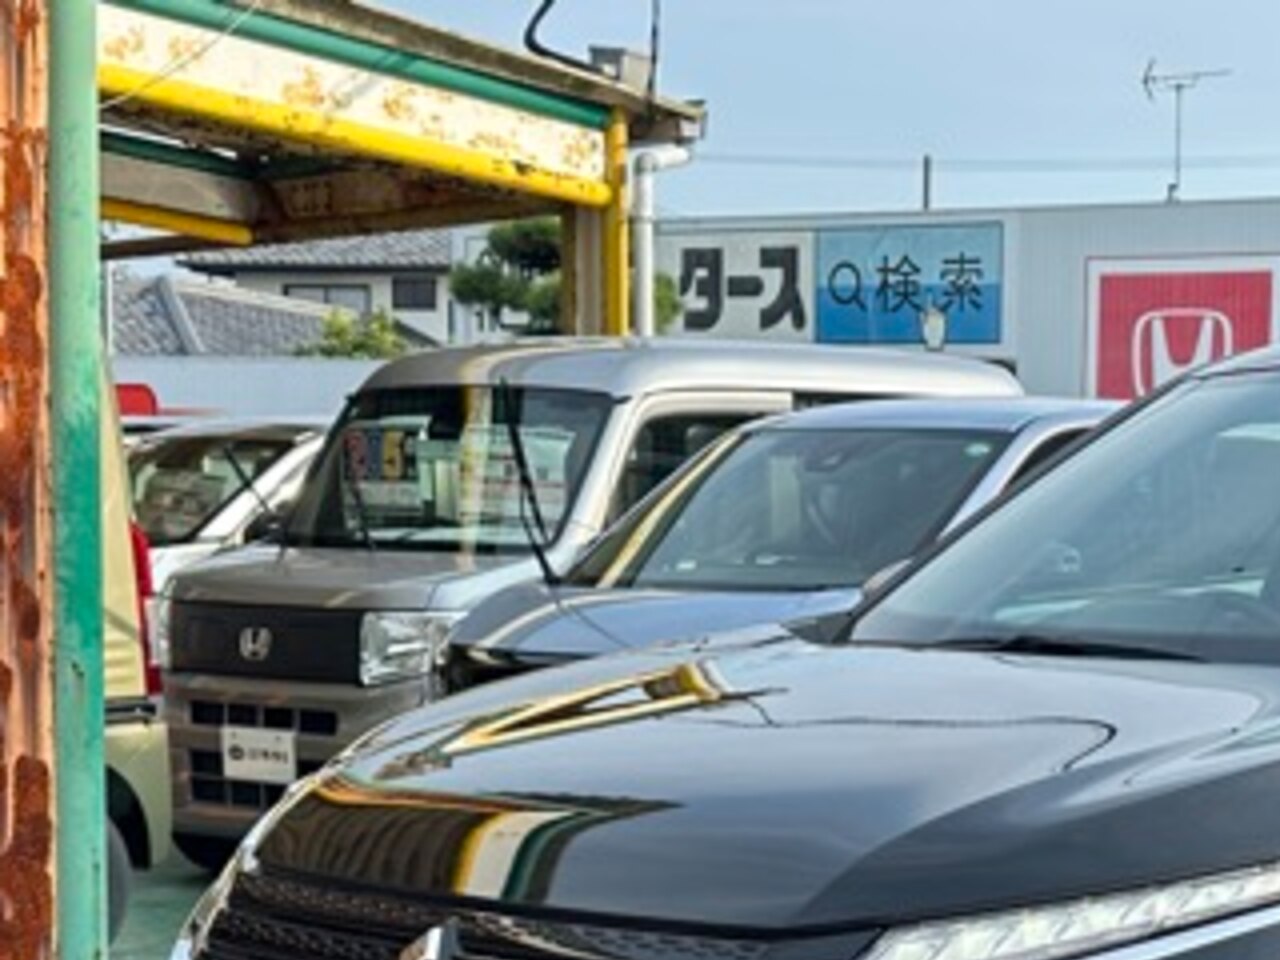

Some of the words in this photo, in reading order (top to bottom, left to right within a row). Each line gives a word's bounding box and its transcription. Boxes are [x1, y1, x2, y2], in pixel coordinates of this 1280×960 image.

[680, 246, 806, 332] タース
[875, 252, 984, 314] 検索
